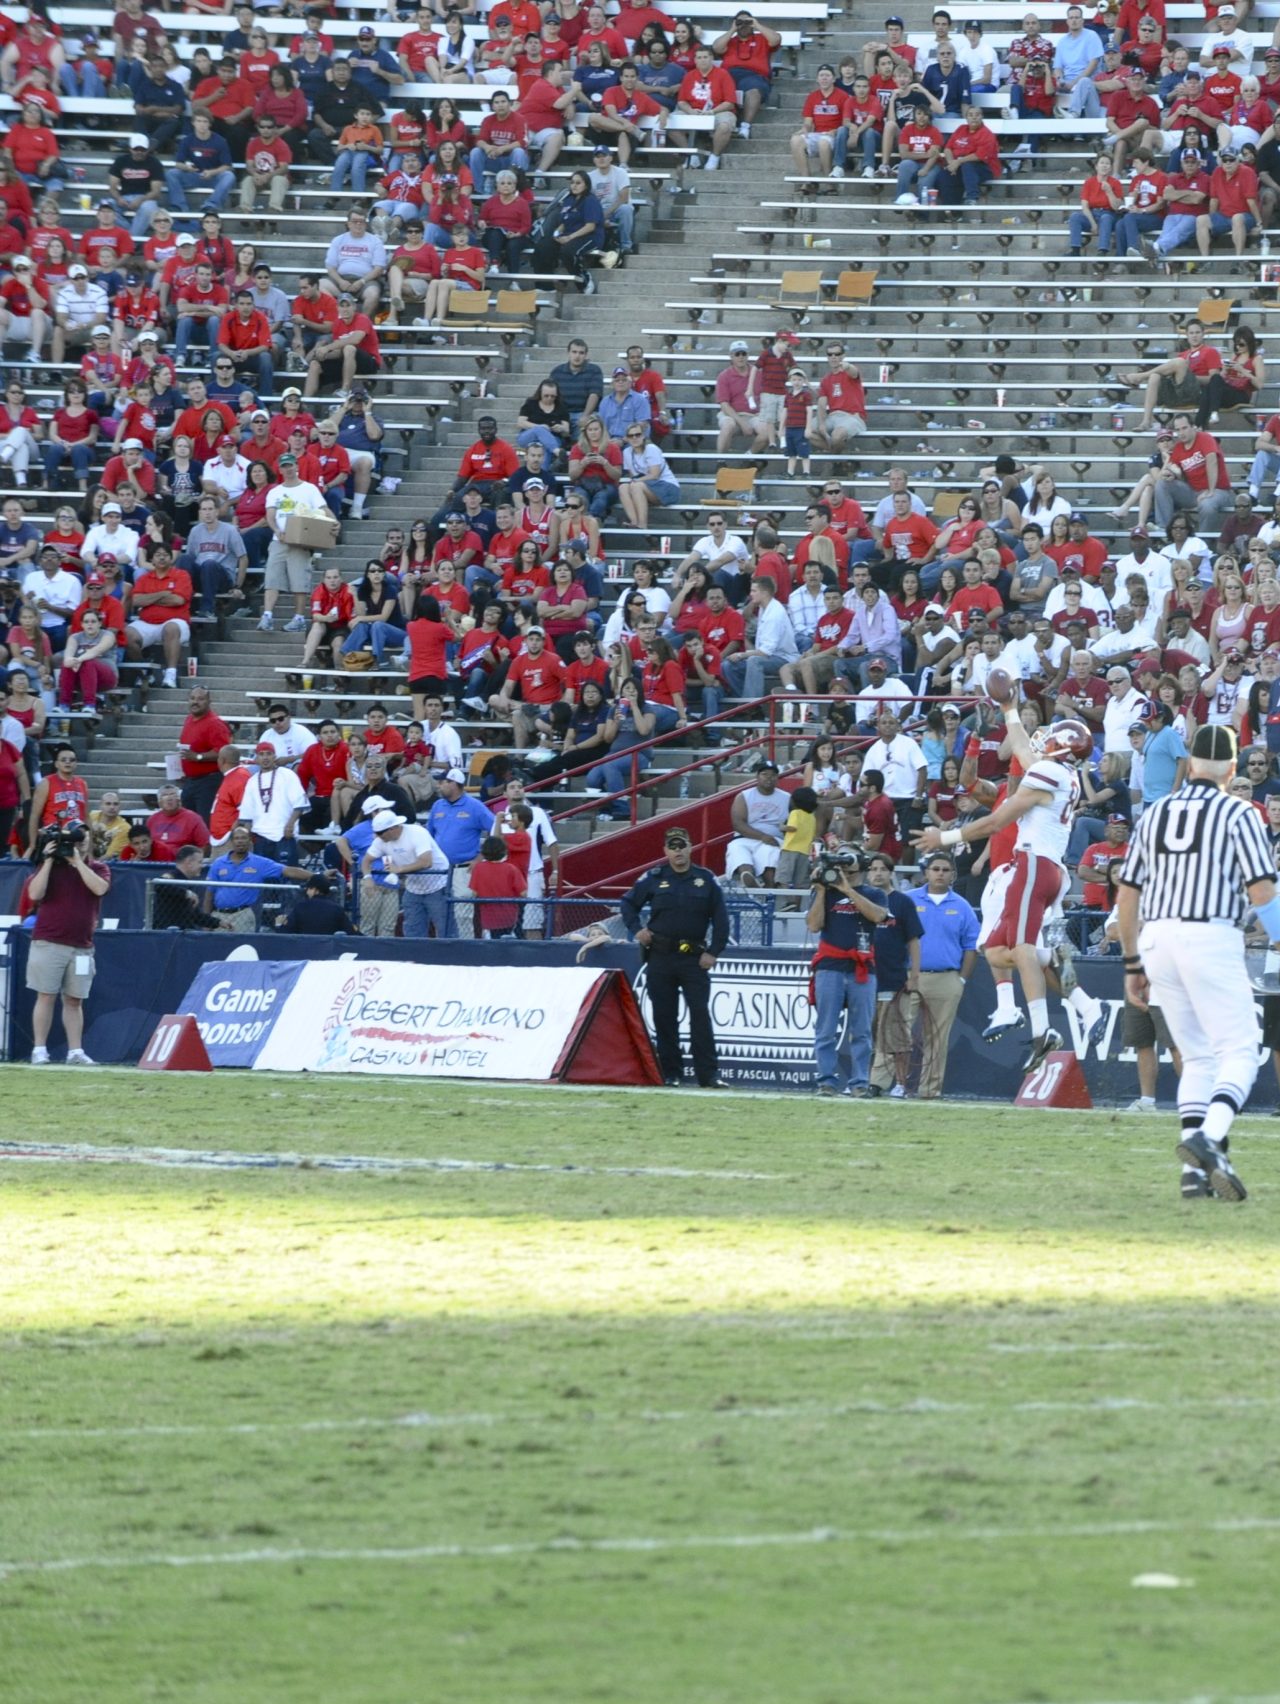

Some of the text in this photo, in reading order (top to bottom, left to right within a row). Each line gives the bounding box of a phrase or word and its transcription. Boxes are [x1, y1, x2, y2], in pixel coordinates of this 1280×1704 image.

[1163, 799, 1204, 852] U
[205, 981, 277, 1013] Game
[343, 993, 545, 1030] DESERT DIAMOND
[711, 990, 816, 1030] CASINO
[147, 1023, 181, 1062] 10
[187, 1013, 271, 1045] ponsor
[432, 1049, 488, 1068] HOTEL
[737, 1069, 776, 1081] PASCUA
[780, 1071, 811, 1084] YAQUI
[1022, 1060, 1063, 1100] 20
